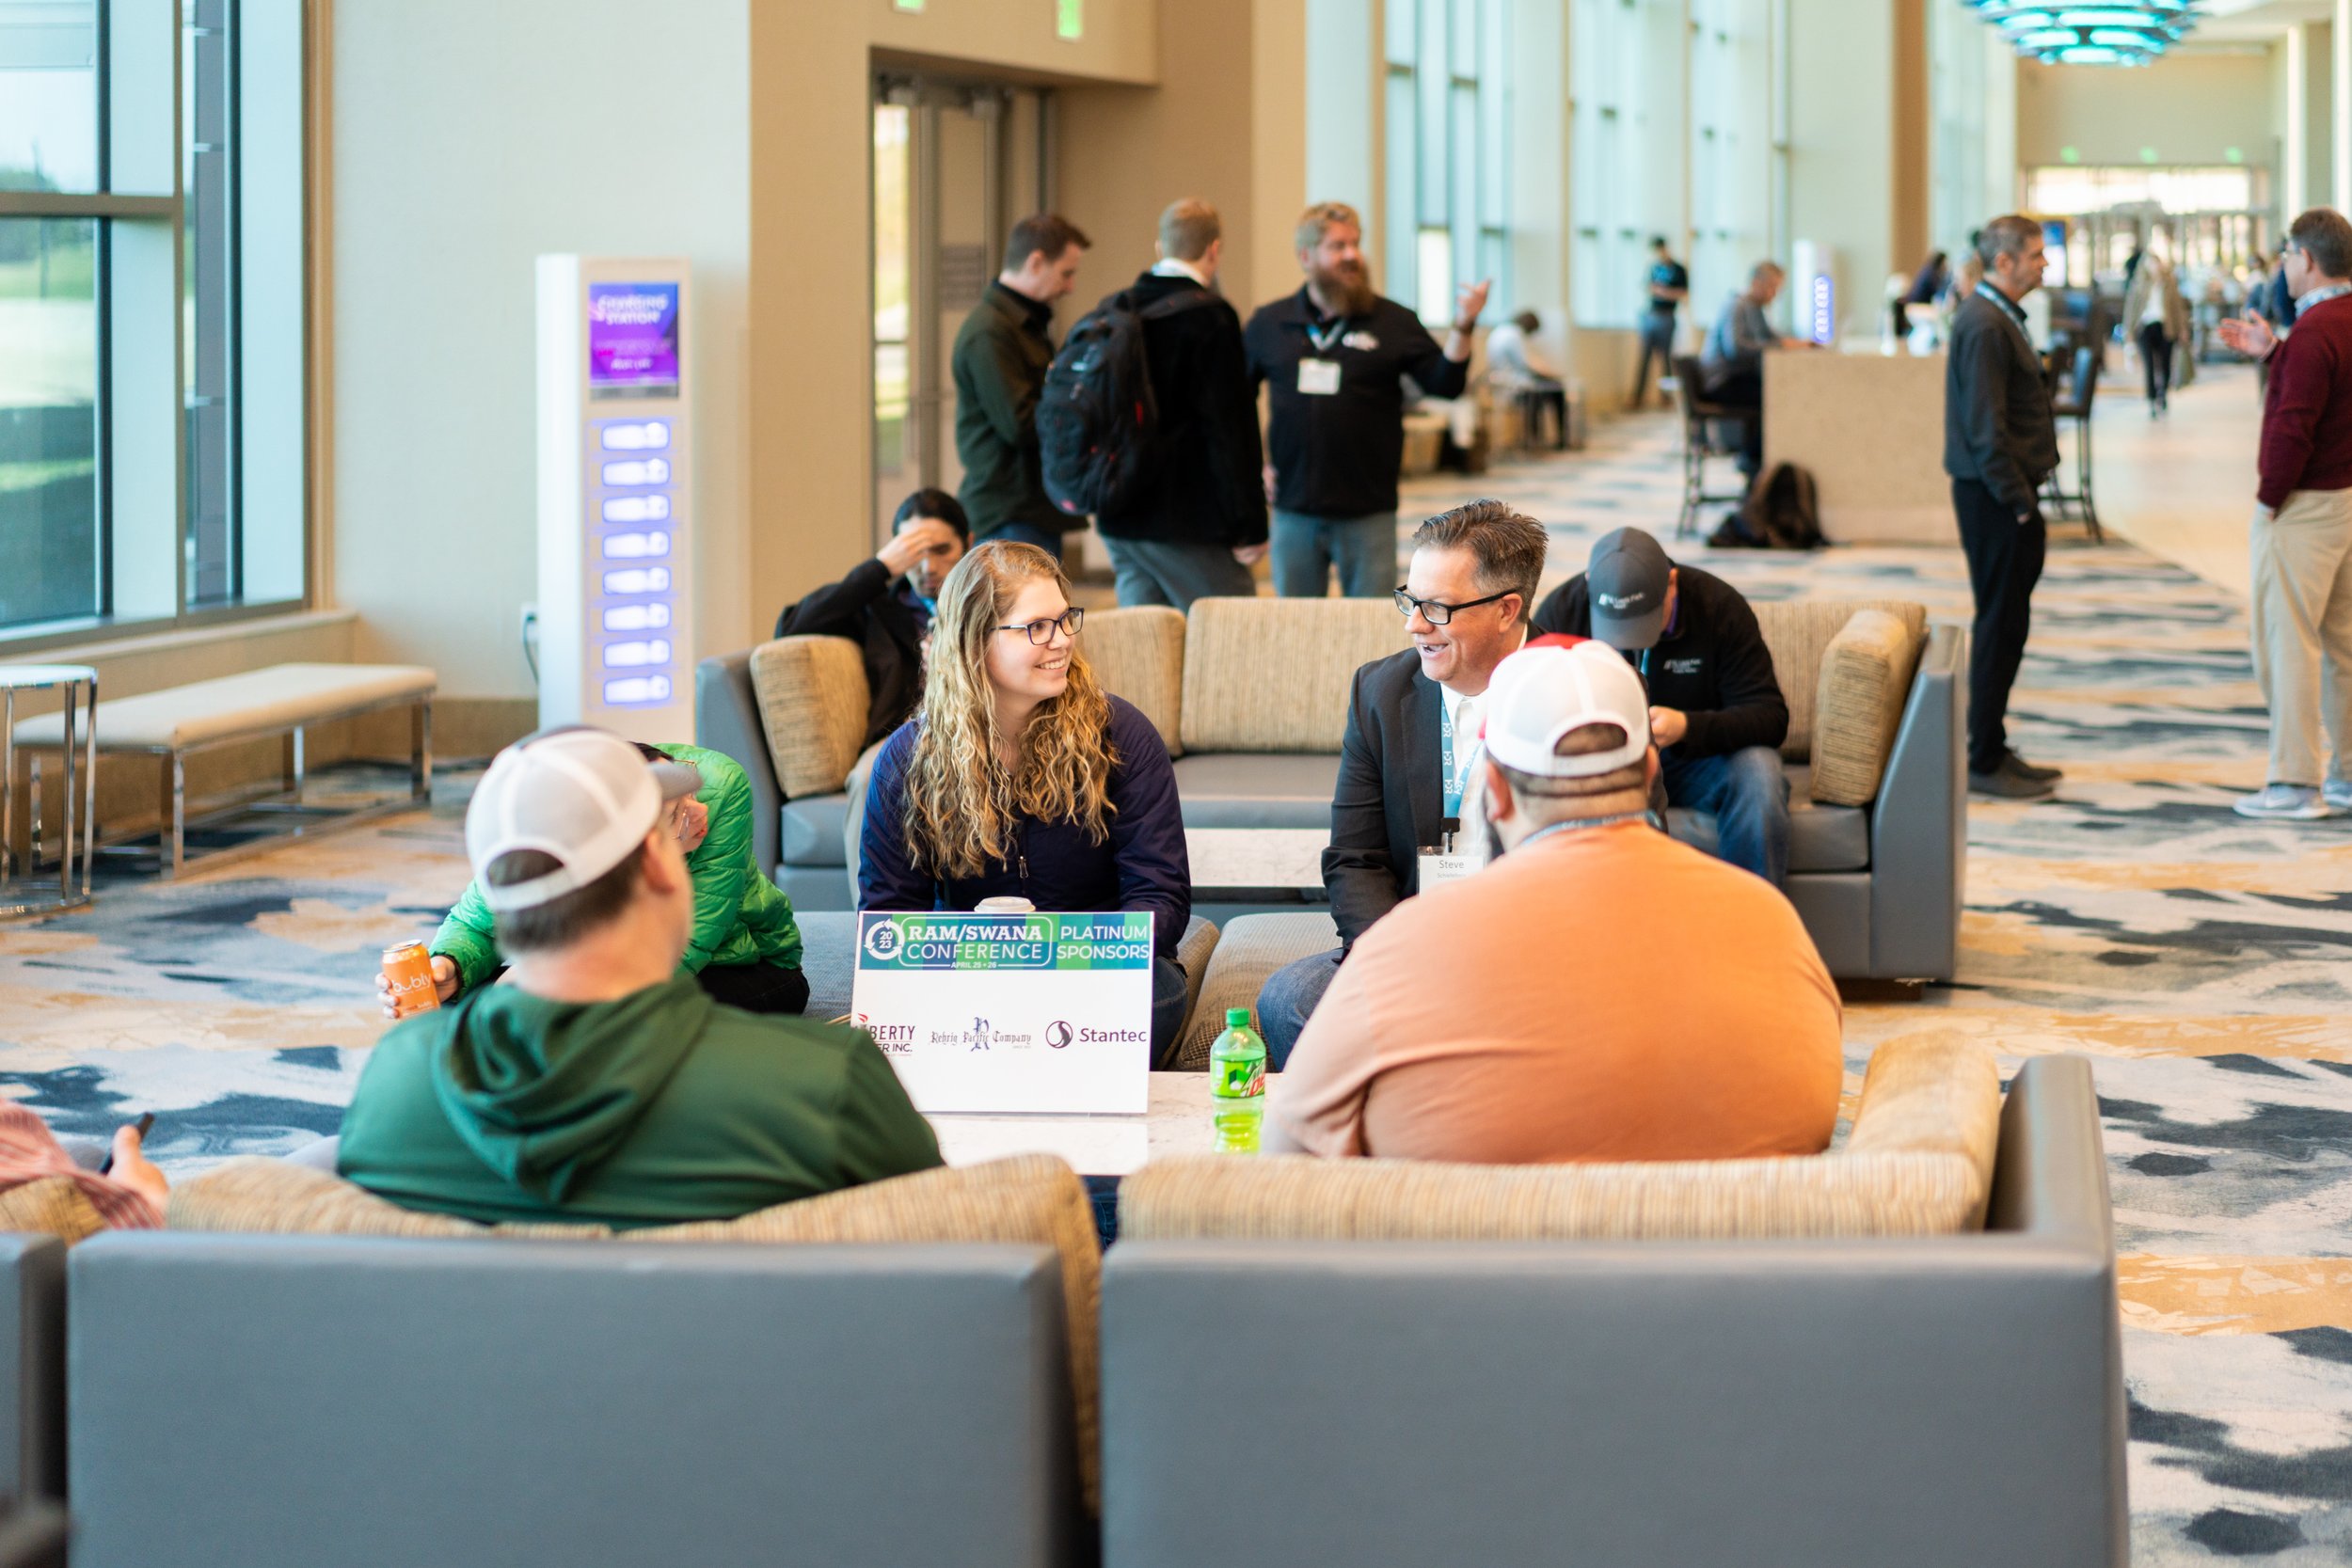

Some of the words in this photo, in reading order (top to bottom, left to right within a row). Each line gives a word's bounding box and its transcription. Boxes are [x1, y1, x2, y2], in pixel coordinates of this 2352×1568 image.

[1439, 860, 1465, 869] Steve
[880, 931, 893, 940] 20
[908, 925, 1043, 942] RAM/SWANA
[1060, 926, 1148, 940] PLATINUM
[879, 941, 892, 949] 23
[907, 943, 1042, 959] CONFERENCE
[1057, 944, 1150, 959] SPONSORS
[993, 1030, 1032, 1045] Company
[1079, 1027, 1147, 1042] Stantec
[892, 1043, 913, 1053] INC.
